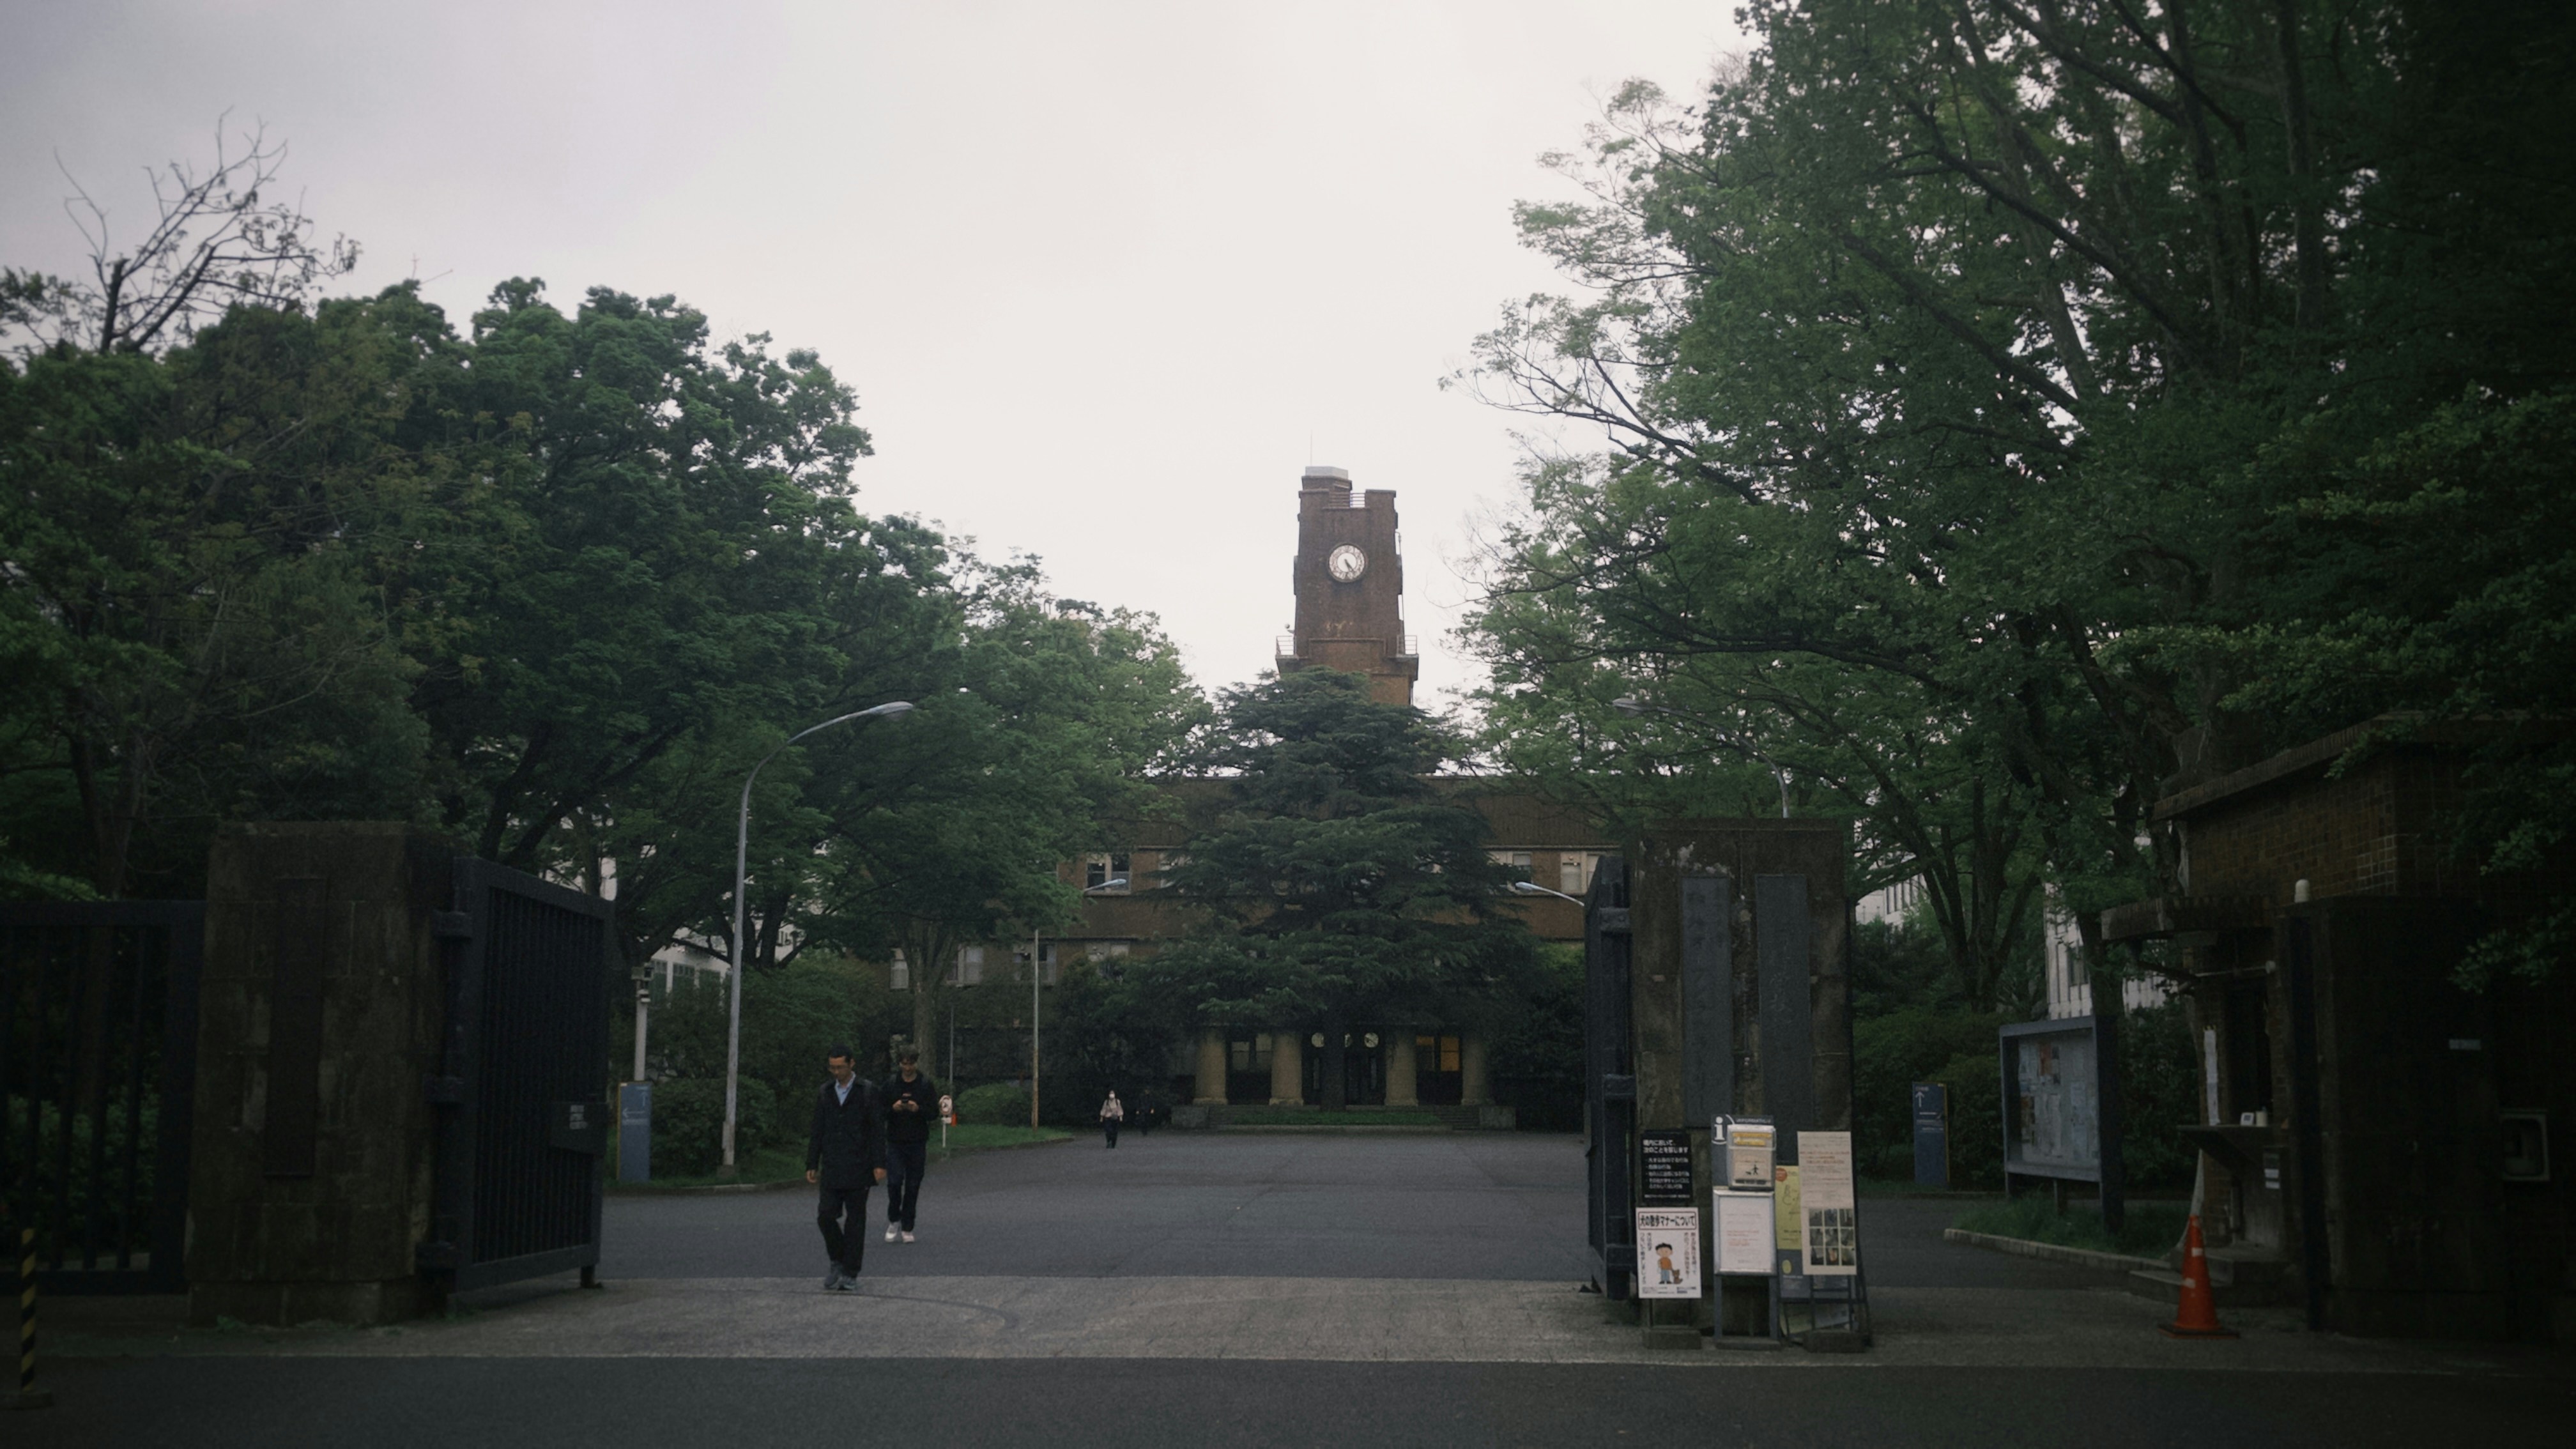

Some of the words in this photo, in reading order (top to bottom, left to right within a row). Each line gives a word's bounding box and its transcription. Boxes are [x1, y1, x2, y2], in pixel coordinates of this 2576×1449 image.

[1639, 1215, 1696, 1227] 犬の散歩マナーについて
